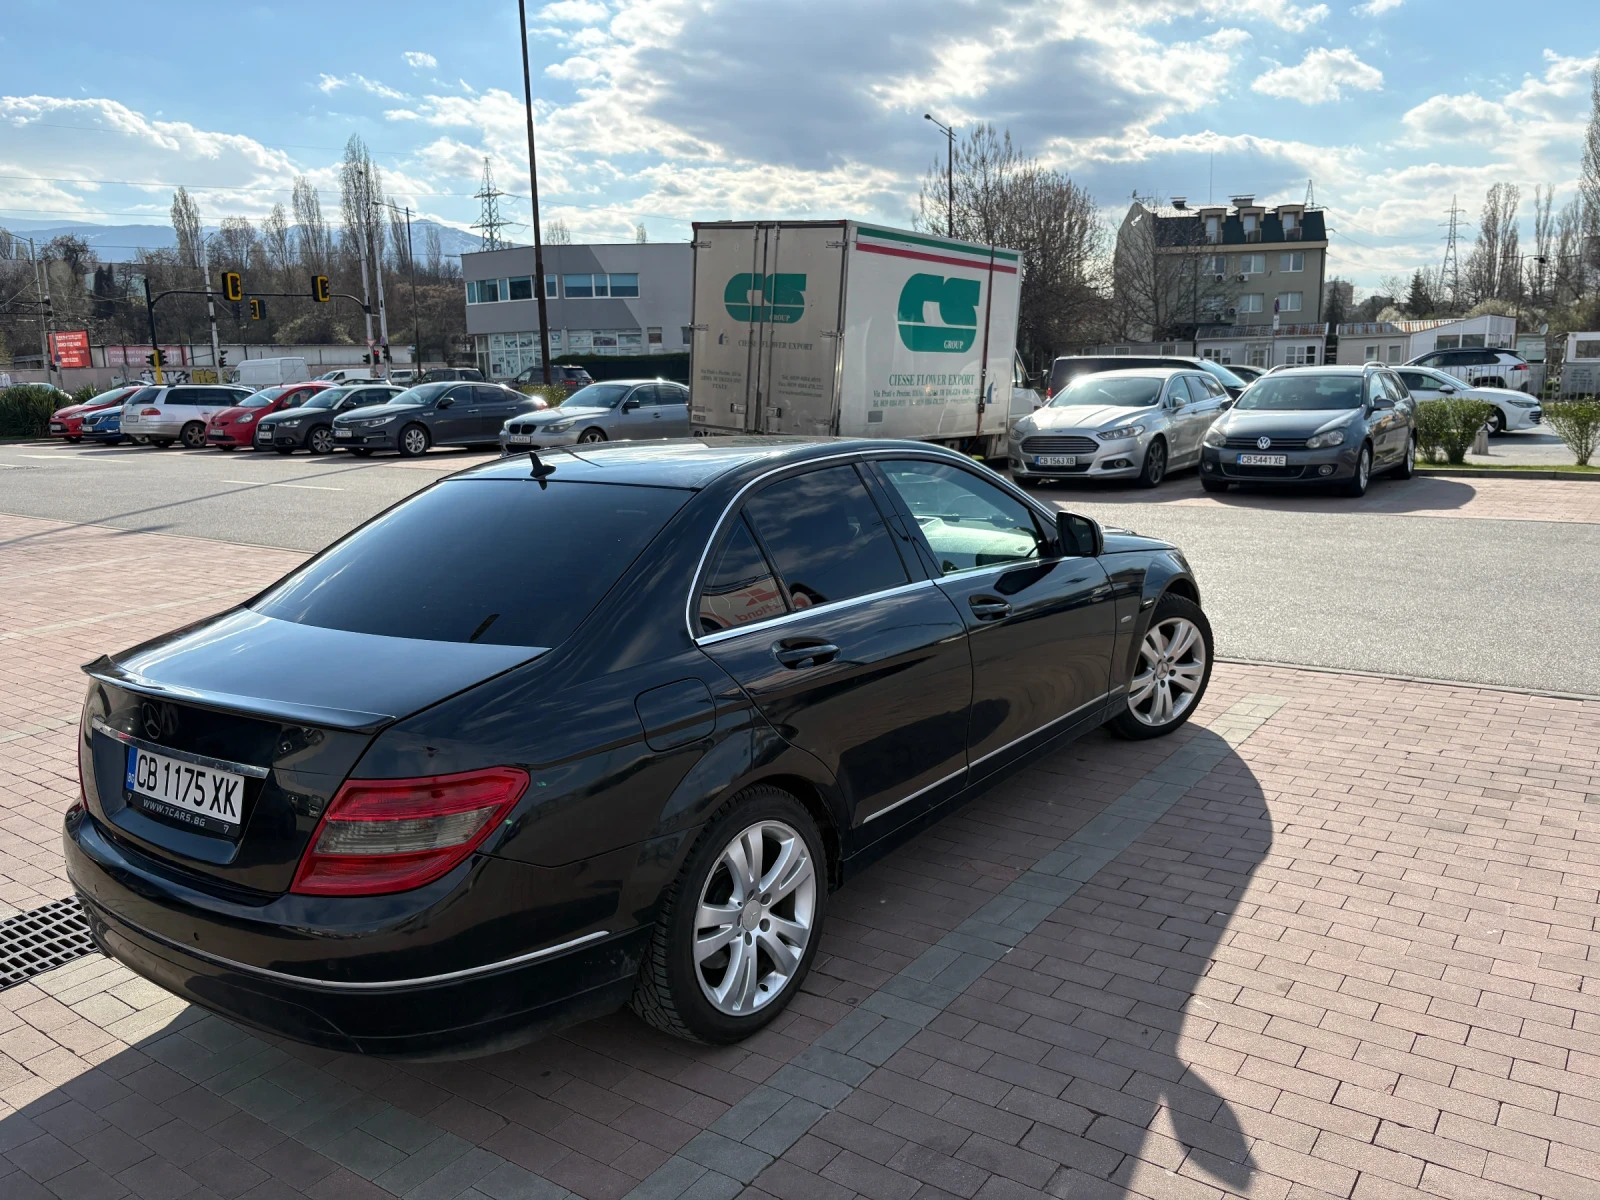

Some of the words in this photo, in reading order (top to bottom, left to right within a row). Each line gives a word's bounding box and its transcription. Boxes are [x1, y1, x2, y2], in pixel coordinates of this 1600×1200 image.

[788, 342, 813, 350] EXPORT
[944, 340, 964, 350] GROUP
[888, 374, 915, 386] CIESSE
[916, 374, 947, 386] FLOWER
[948, 374, 975, 386] EXPORT
[1242, 456, 1252, 464] CB
[1253, 456, 1272, 464] 5441
[1274, 456, 1284, 465] XE
[137, 754, 158, 792] CB
[164, 762, 206, 806] 1175
[209, 774, 239, 818] XK
[143, 799, 206, 827] WWW.7CARS.BG
